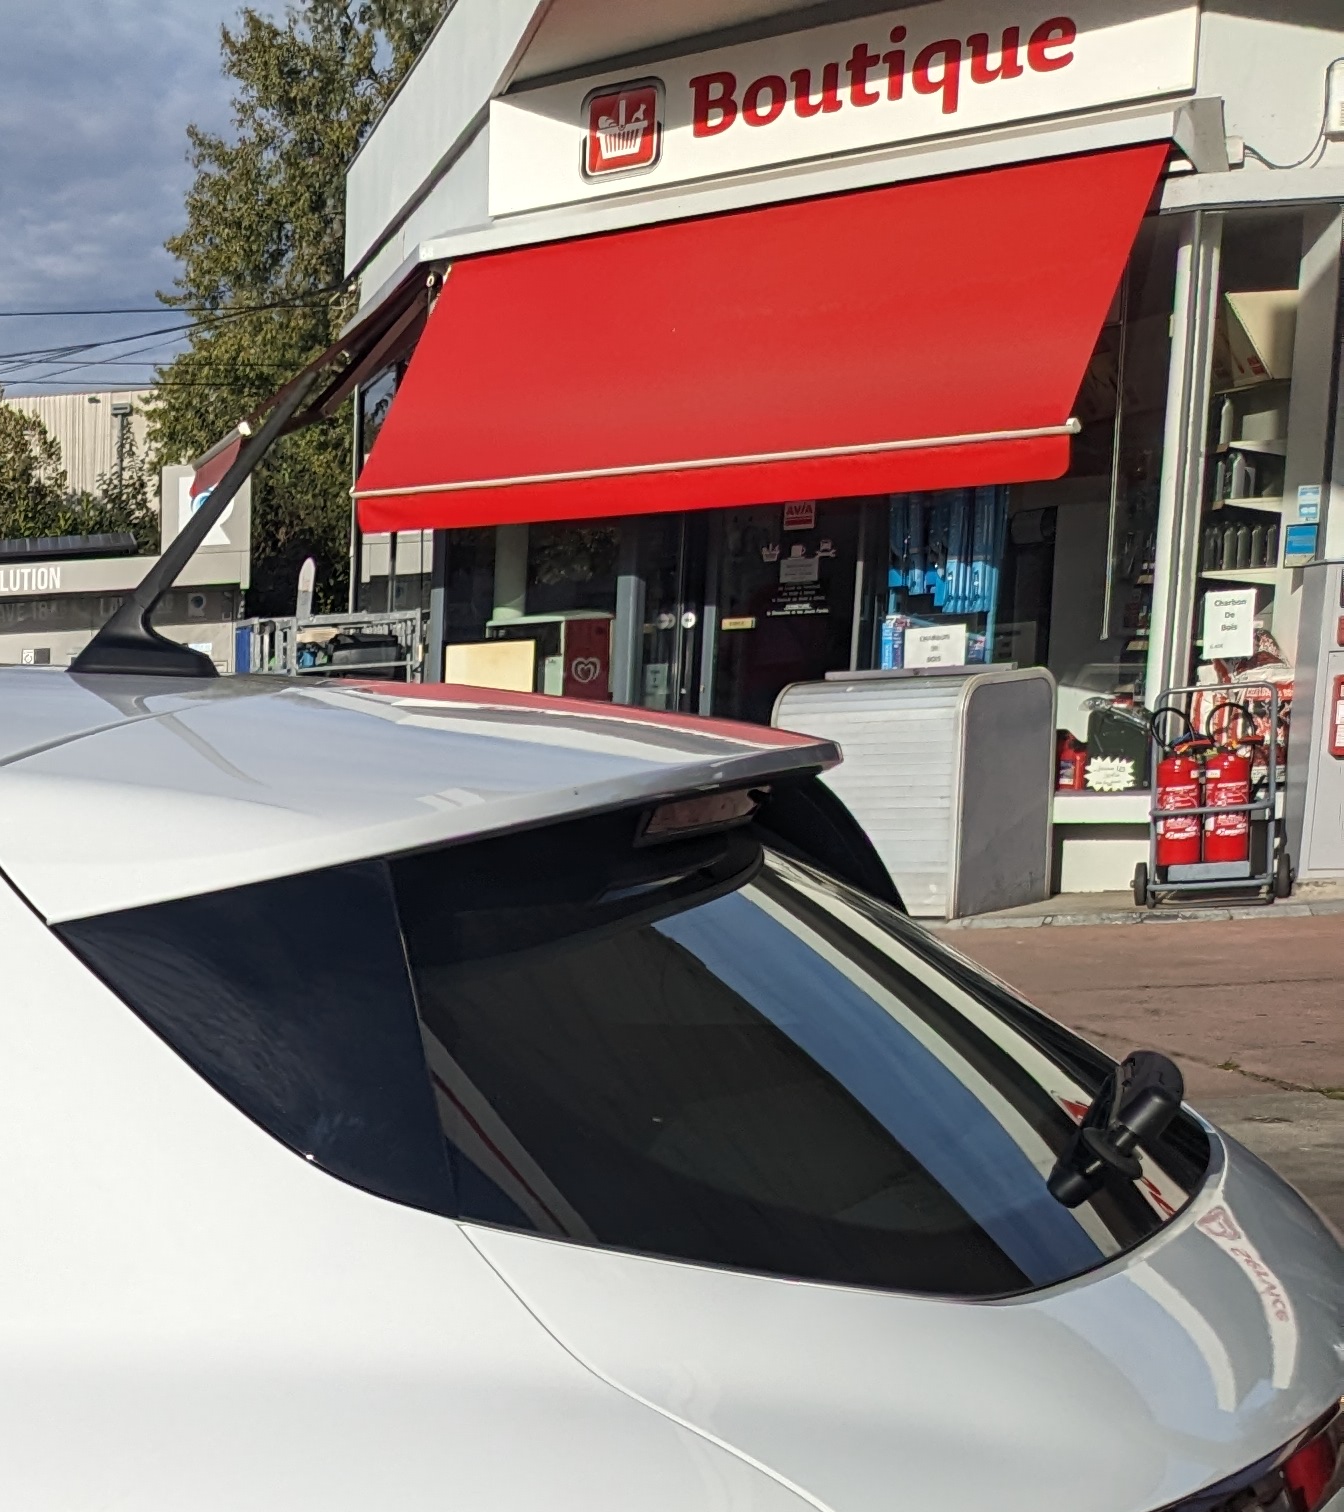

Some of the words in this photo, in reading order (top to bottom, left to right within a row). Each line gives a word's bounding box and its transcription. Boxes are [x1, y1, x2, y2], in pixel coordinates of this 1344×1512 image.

[688, 15, 1077, 139] Boutique
[785, 501, 813, 516] AVIA
[1214, 599, 1247, 607] Charbon
